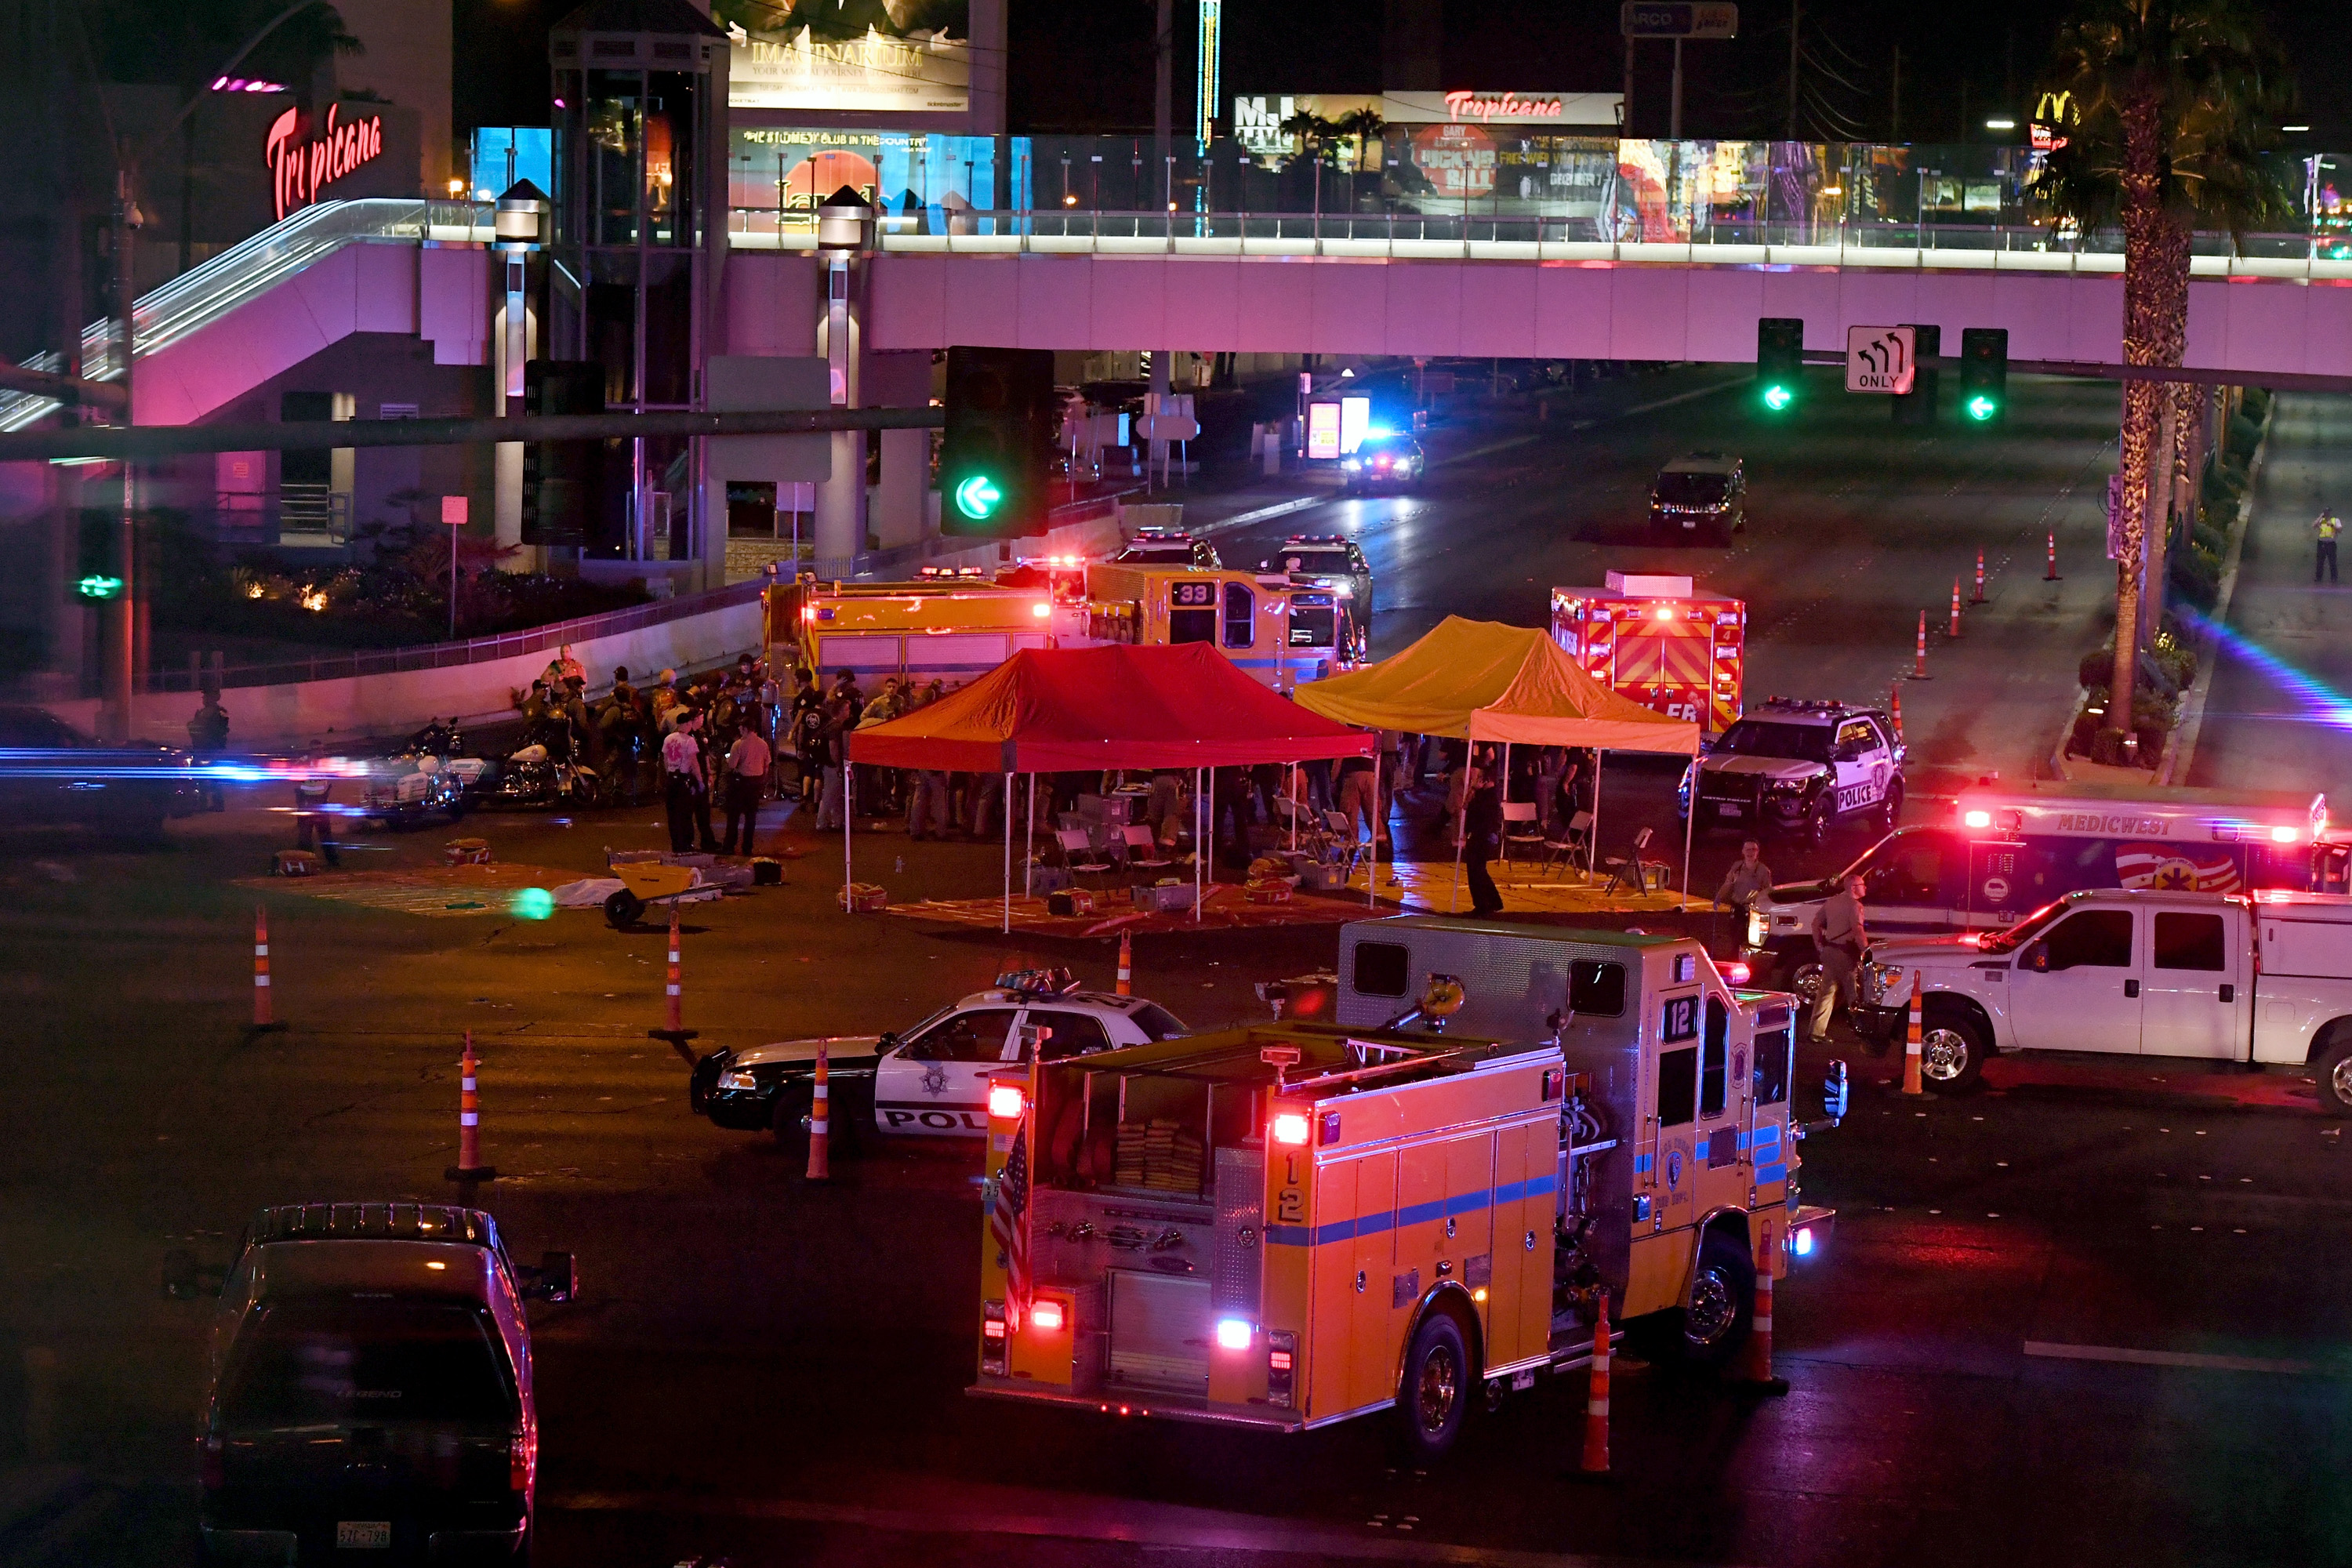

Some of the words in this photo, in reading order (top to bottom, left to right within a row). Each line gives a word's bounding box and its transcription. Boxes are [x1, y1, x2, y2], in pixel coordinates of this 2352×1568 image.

[752, 42, 923, 67] IMAGINARIUM
[752, 67, 779, 76] YOUR
[782, 67, 819, 76] MAGICAL
[823, 67, 864, 77] JOURNEY
[1235, 96, 1294, 126] MJ
[1445, 91, 1562, 123] Tropicana
[820, 132, 848, 145] CLUB
[849, 135, 859, 145] IN
[860, 135, 880, 146] THE
[1443, 125, 1466, 137] GARY
[1860, 375, 1899, 387] ONLY
[1179, 585, 1207, 604] 33
[1723, 630, 1731, 641] 4
[1839, 785, 1871, 809] POLICE
[2056, 814, 2175, 836] MEDICWEST
[1671, 1000, 1690, 1035] 12
